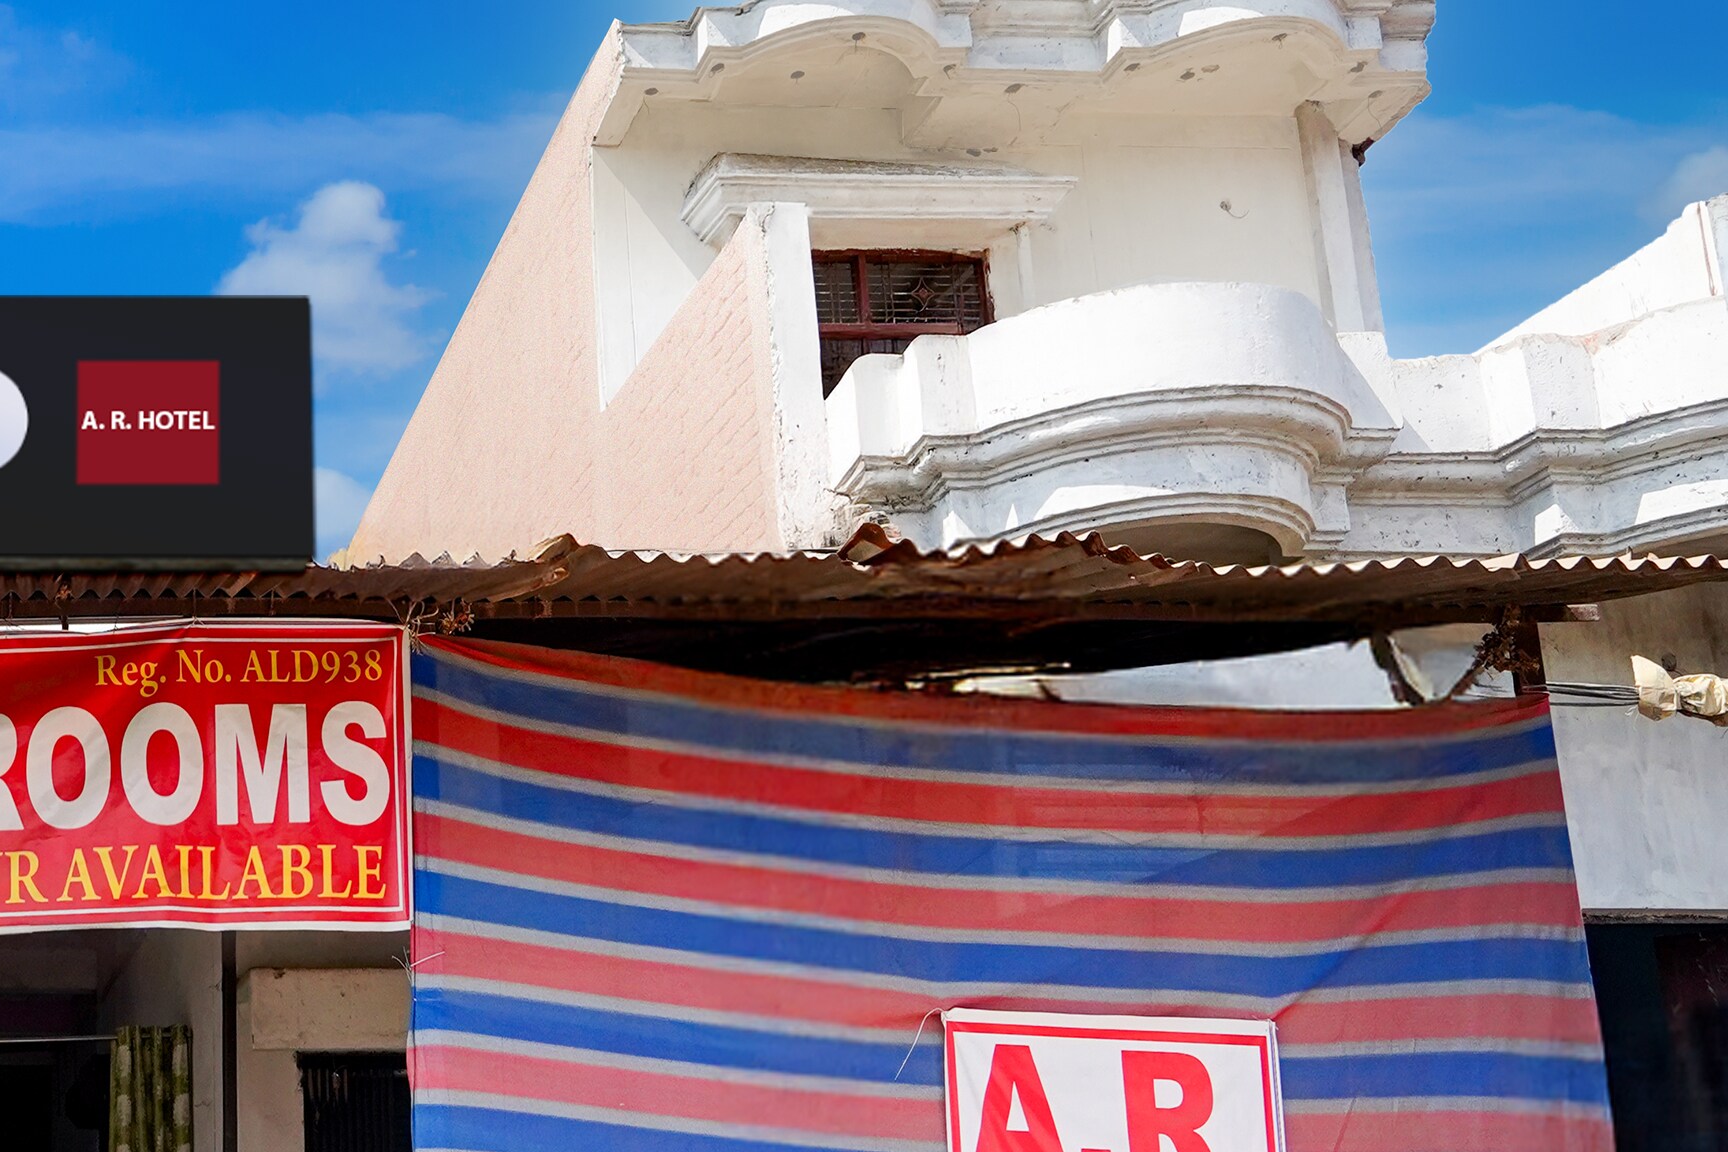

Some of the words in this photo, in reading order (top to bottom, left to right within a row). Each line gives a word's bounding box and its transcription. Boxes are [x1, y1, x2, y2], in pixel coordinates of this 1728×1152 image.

[81, 410, 106, 430] A.
[110, 410, 132, 430] R.
[138, 410, 216, 430] HOTEL
[95, 653, 165, 696] Reg.
[176, 649, 232, 684] No.
[240, 649, 383, 684] ALD938
[59, 844, 387, 902] AVAILABLE
